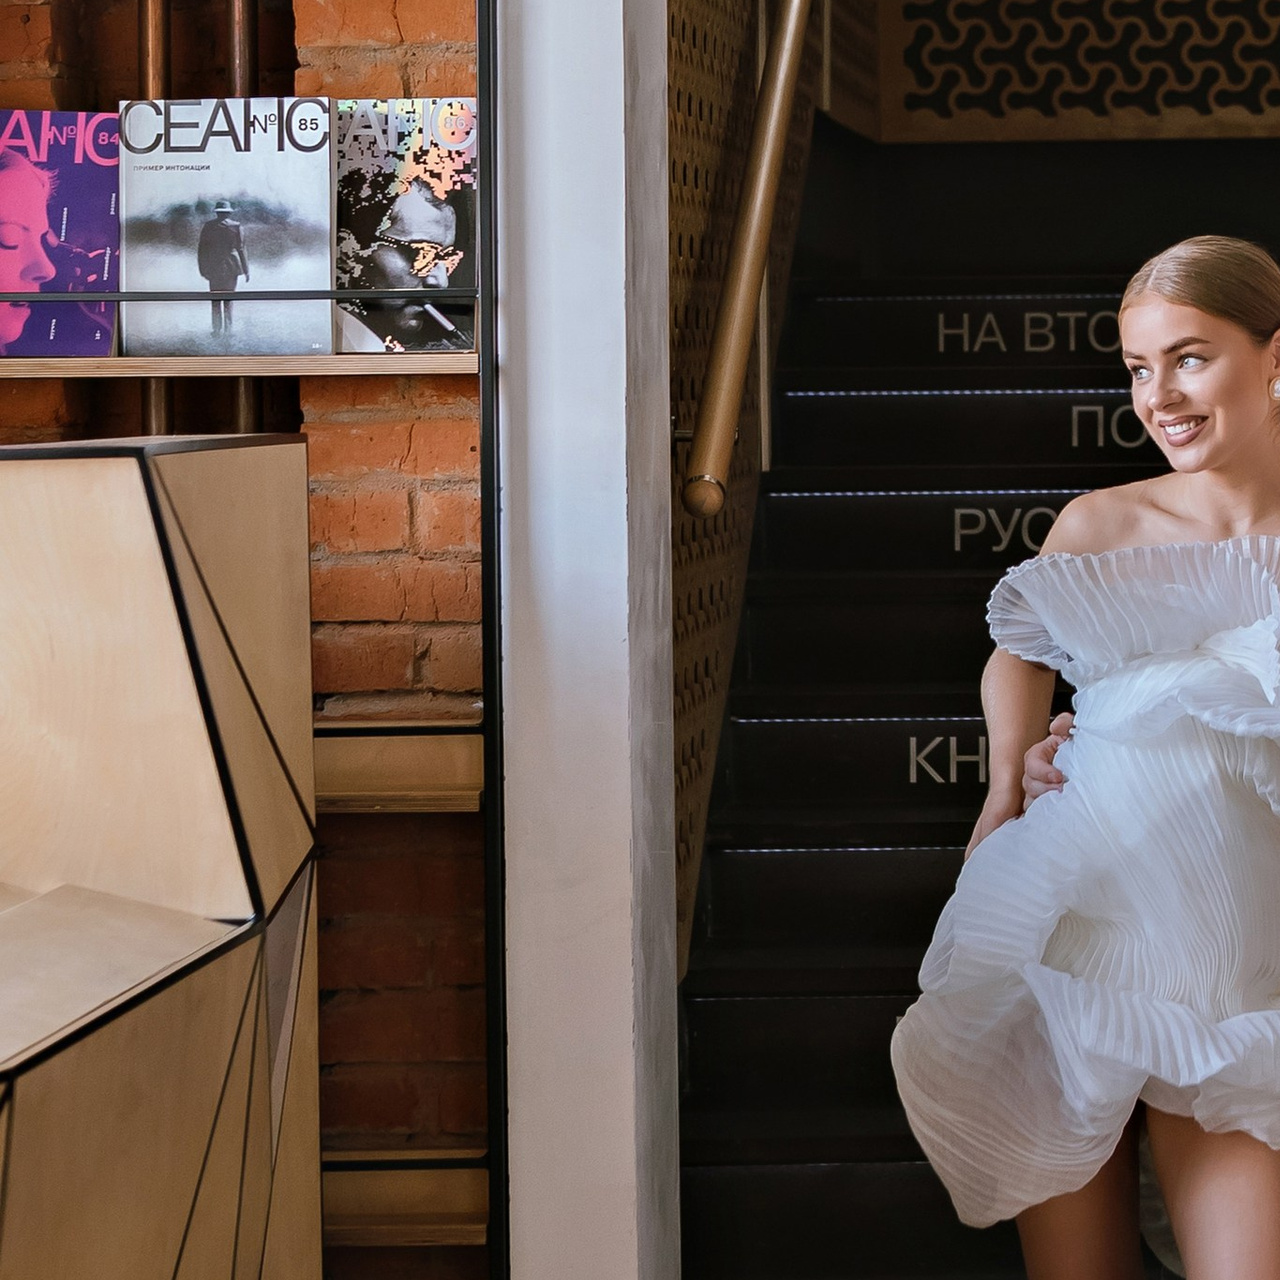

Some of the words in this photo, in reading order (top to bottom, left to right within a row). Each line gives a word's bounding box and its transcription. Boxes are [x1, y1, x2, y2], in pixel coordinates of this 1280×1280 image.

[119, 98, 330, 155] СЕАНС
[250, 113, 278, 135] №
[298, 118, 319, 131] 85
[133, 164, 164, 172] ПРИМЕР
[165, 164, 211, 172] ИНТОНАЦИИ
[937, 312, 1007, 353] НА
